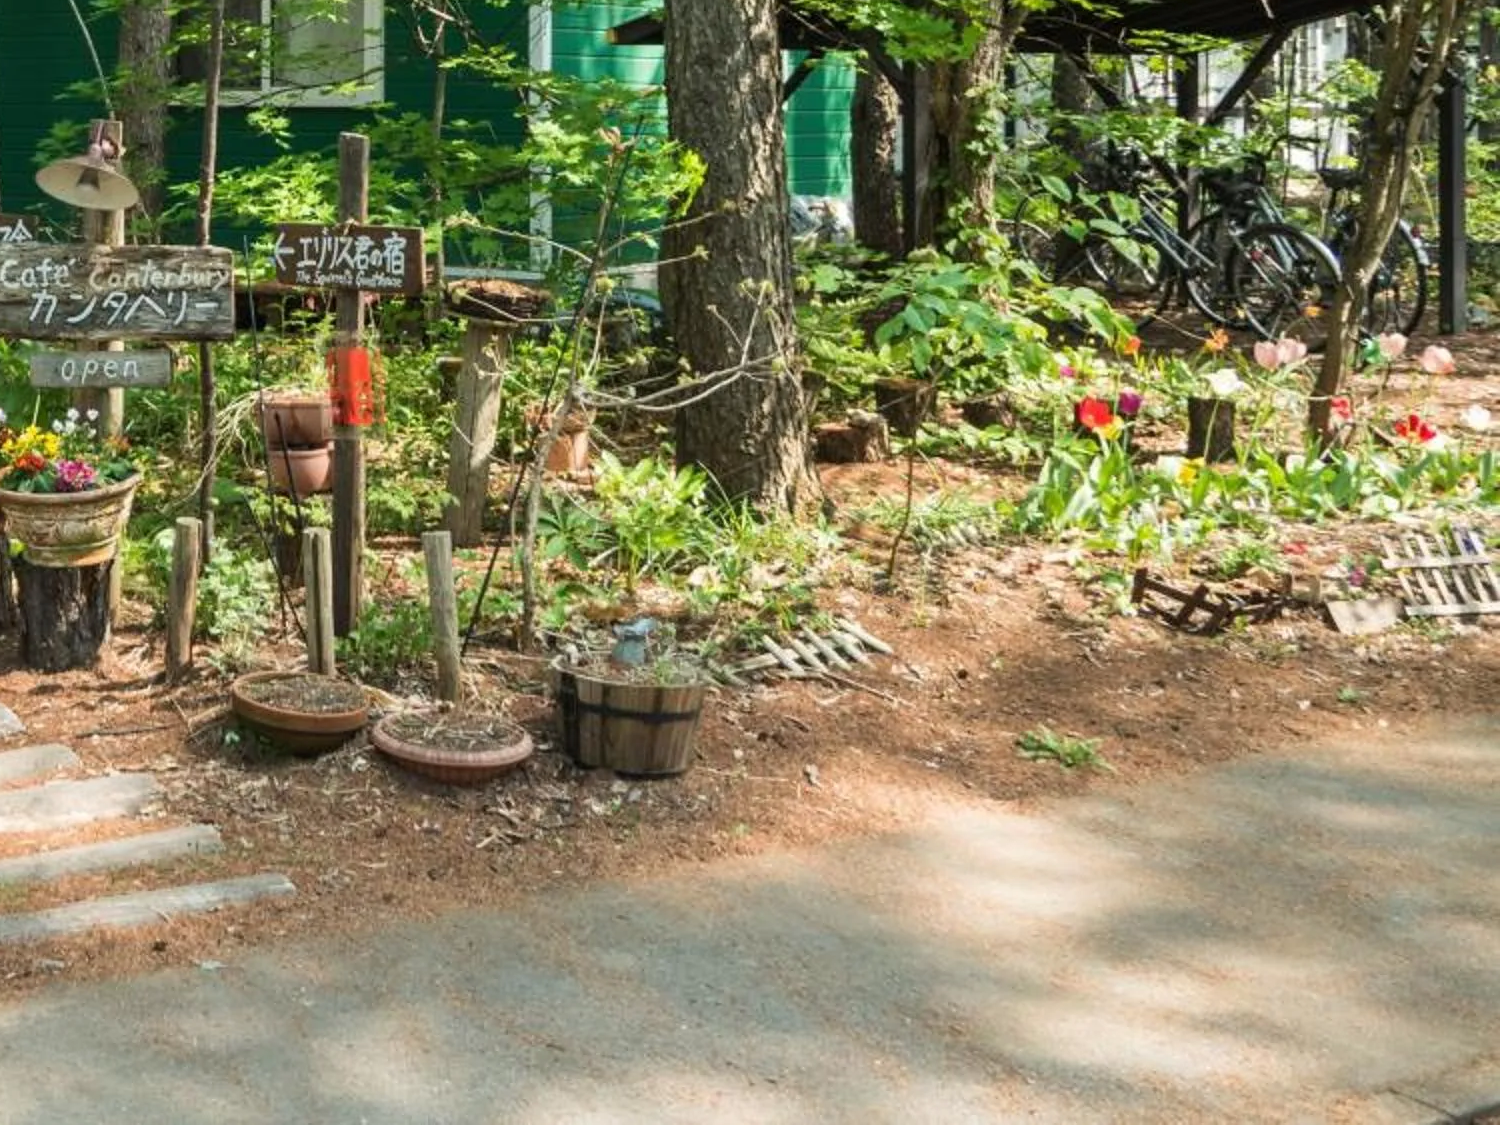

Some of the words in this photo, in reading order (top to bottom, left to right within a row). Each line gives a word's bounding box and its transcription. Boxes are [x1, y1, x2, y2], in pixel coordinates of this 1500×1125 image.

[296, 227, 407, 275] エゾリス君の宿
[0, 258, 76, 288] Café
[89, 259, 230, 292] Canterbury
[28, 289, 220, 325] カンタベリー
[60, 358, 139, 385] open
